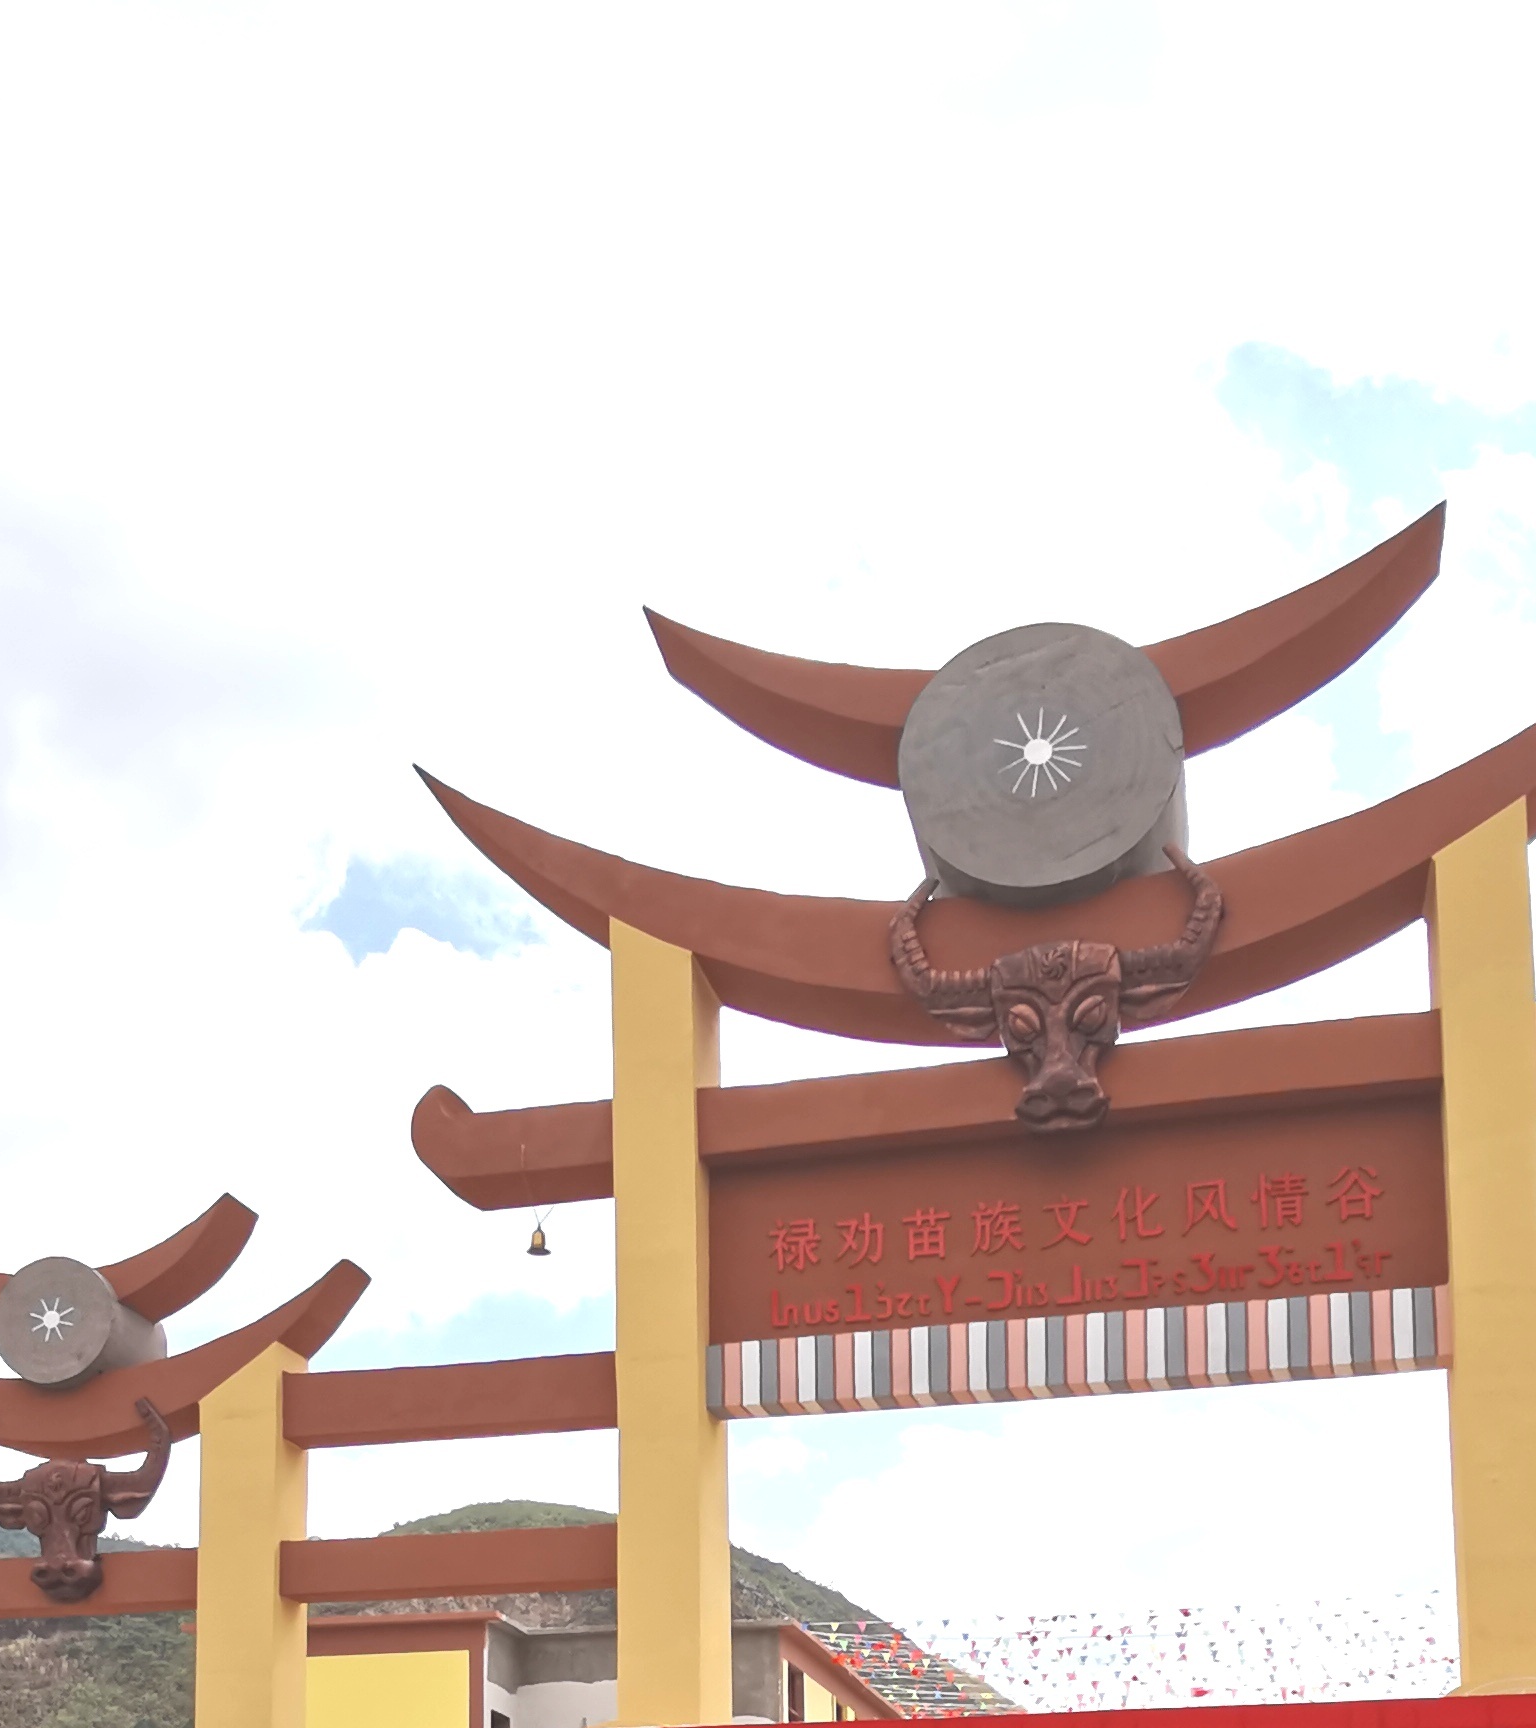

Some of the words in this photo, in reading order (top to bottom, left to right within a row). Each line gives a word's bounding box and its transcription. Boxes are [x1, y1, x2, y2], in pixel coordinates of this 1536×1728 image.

[768, 1166, 1386, 1275] 禄劝苗族文化风情谷
